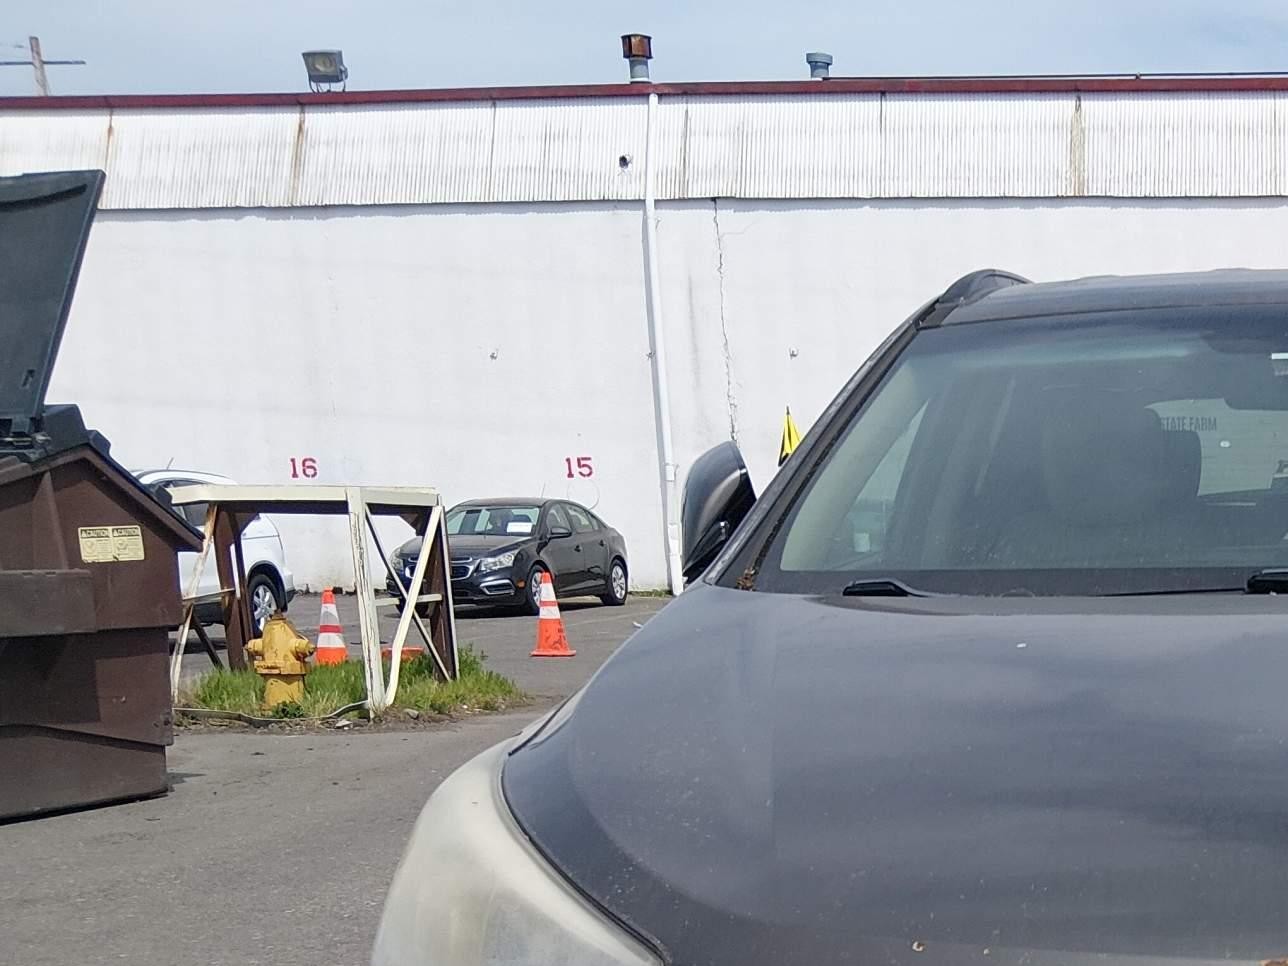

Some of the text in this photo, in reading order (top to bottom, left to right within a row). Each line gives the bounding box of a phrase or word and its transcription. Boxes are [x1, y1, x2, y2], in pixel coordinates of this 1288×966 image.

[1189, 416, 1217, 432] FARM
[290, 457, 318, 479] 16
[565, 456, 594, 478] 15
